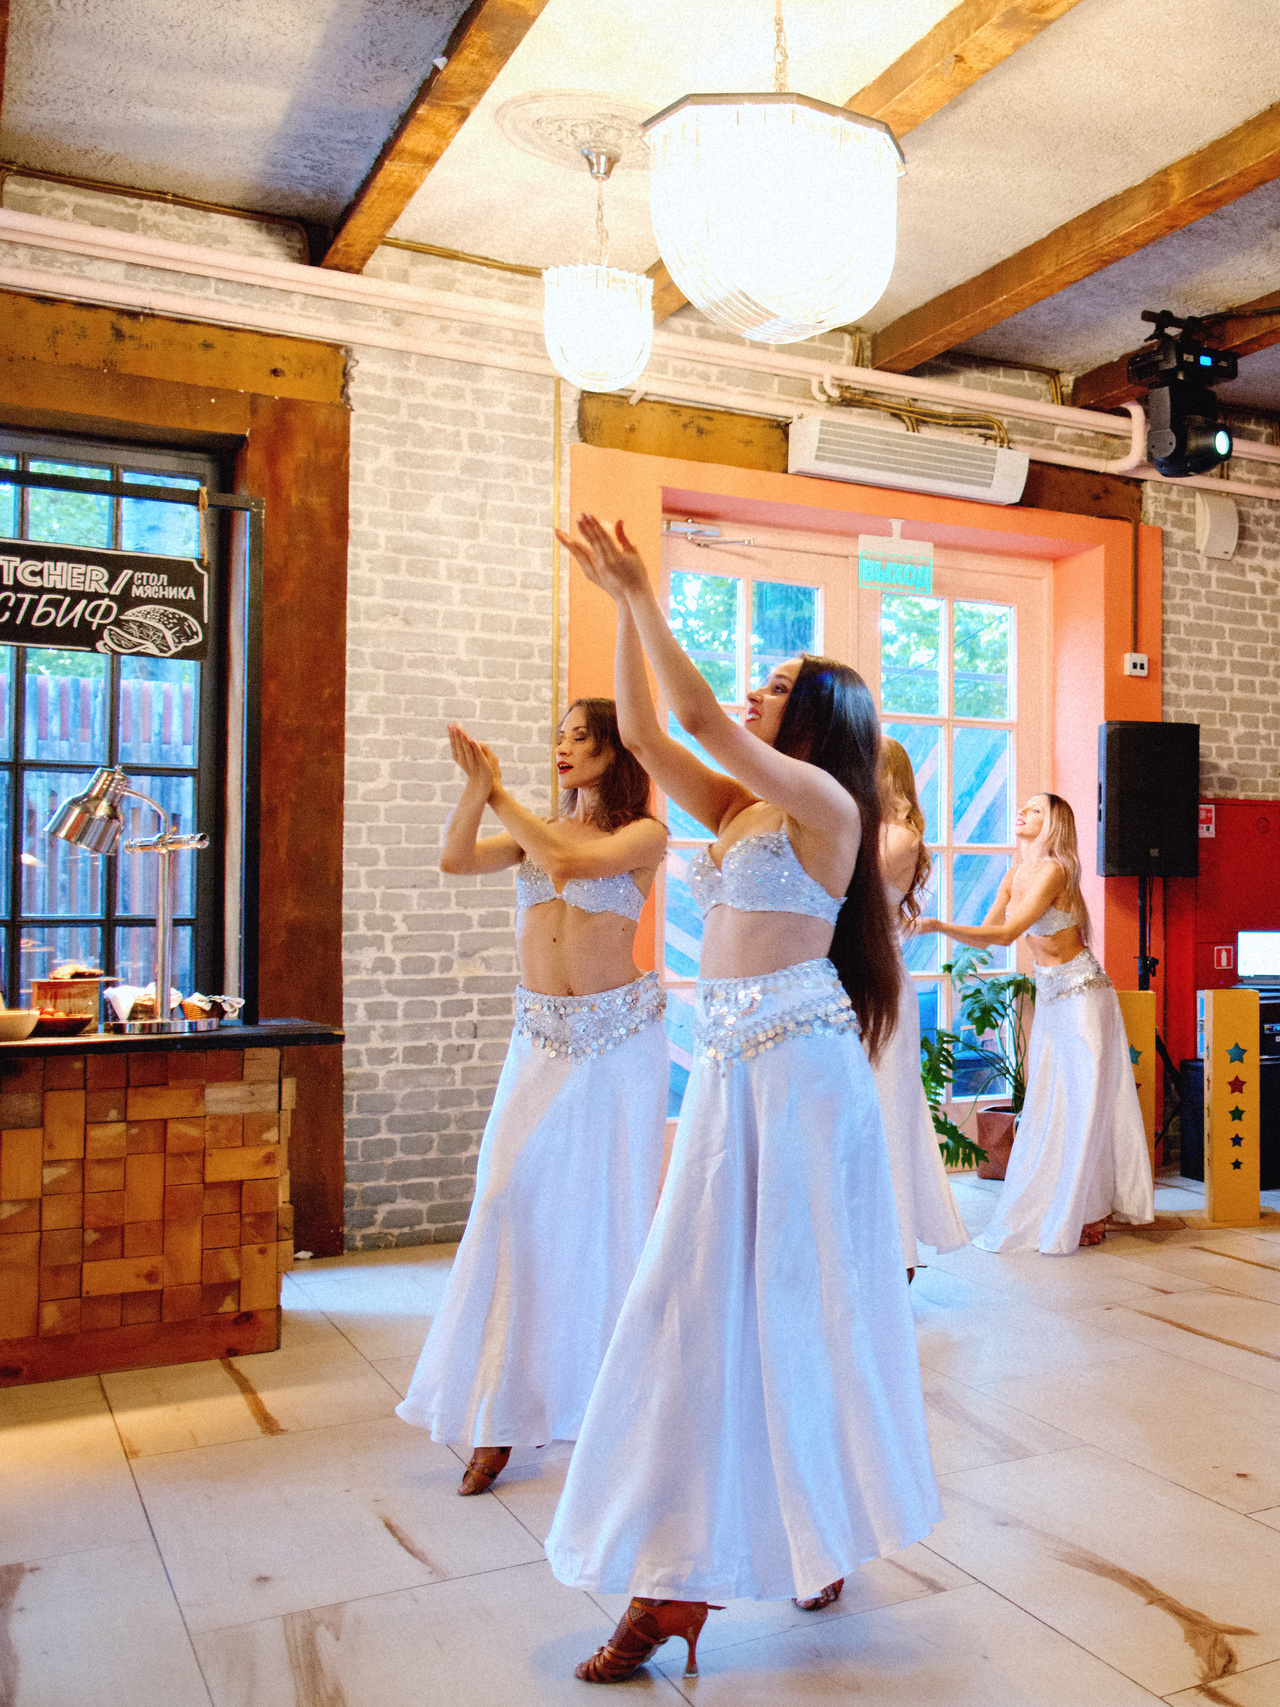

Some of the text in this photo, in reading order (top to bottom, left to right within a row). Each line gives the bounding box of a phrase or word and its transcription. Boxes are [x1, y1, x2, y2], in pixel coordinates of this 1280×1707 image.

[133, 571, 168, 586] СТОЛ
[861, 559, 930, 592] ВЫХОД
[131, 584, 196, 600] МЯСНИКА
